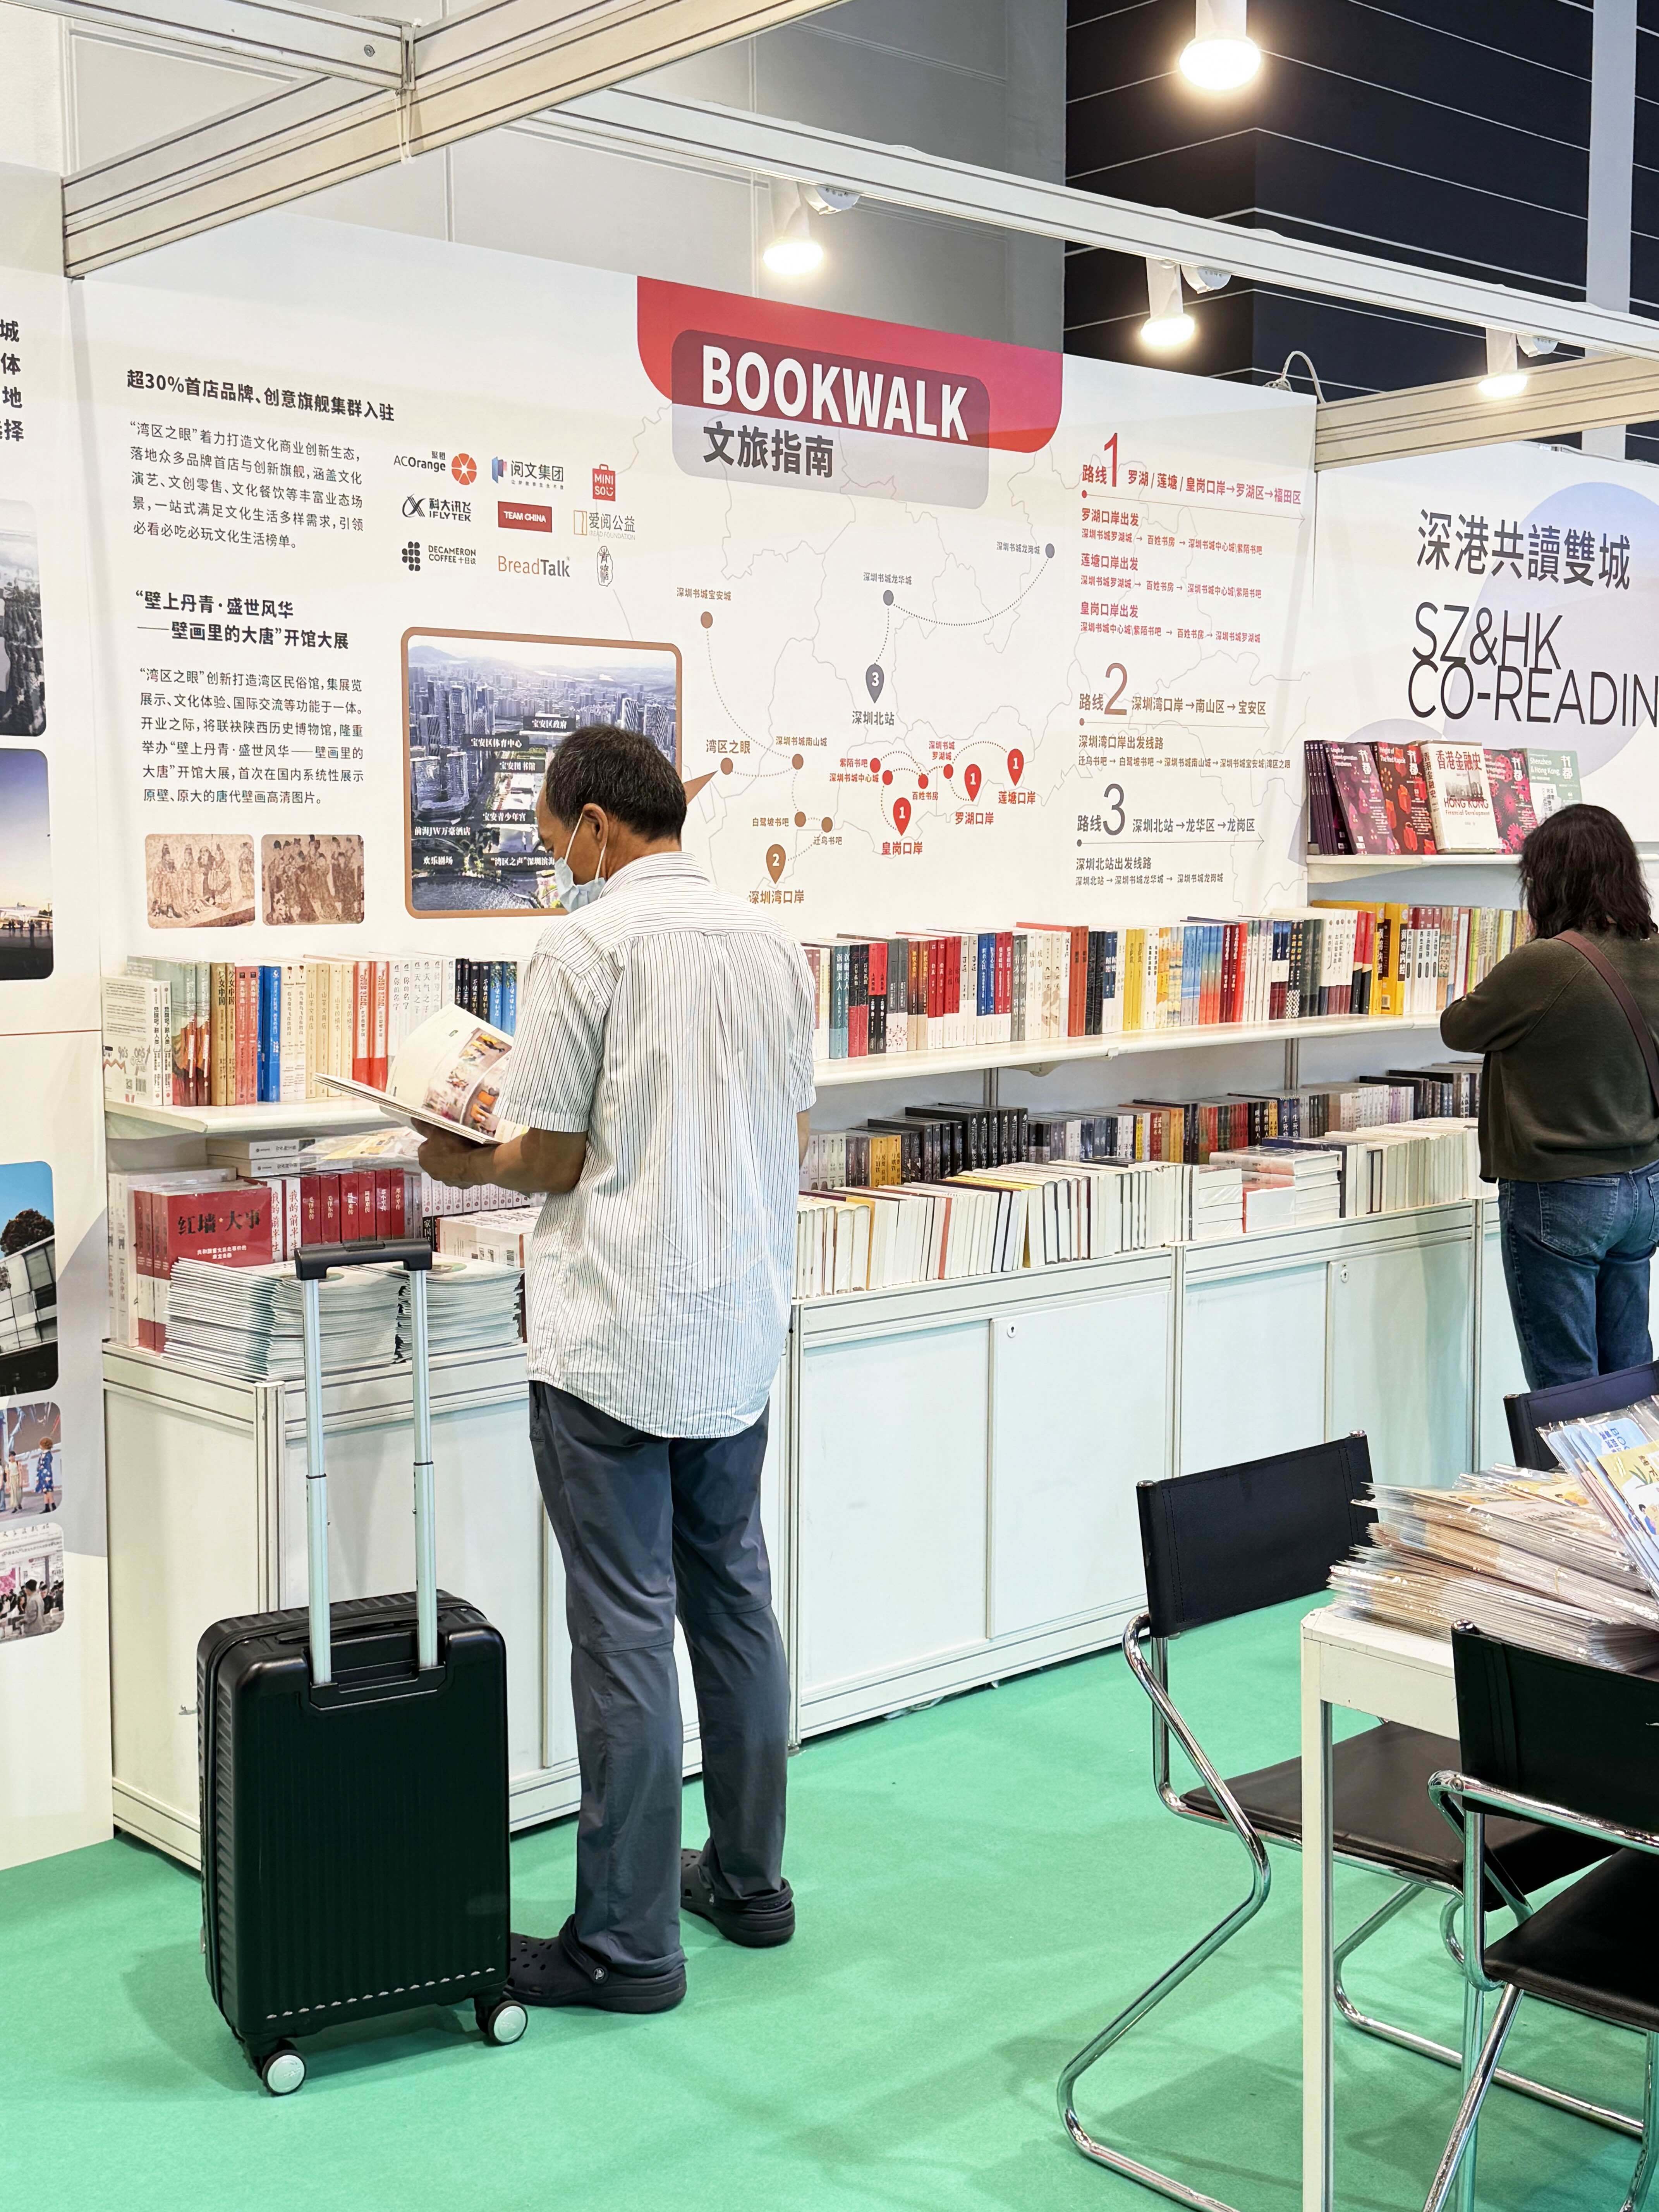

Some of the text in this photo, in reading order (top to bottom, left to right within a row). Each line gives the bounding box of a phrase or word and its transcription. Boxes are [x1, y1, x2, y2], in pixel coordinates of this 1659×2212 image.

[0, 319, 20, 342] 城
[0, 352, 21, 375] 体
[2, 386, 22, 409] 地
[127, 369, 394, 423] 超30%首店品牌、创意旗舰集群入驻
[702, 344, 969, 442] BOOKWALK
[0, 418, 24, 442] 择
[703, 421, 833, 479] 文旅指南
[393, 455, 446, 472] ACOrange
[1104, 432, 1117, 487] 1
[511, 460, 563, 482] 阅文集团
[594, 474, 614, 484] MINI
[429, 498, 471, 513] 科大讯飞
[429, 510, 471, 522] IFLYTEK
[503, 511, 546, 524] TEAM CHINA
[589, 511, 635, 532] 爱阅公益
[1081, 508, 1139, 527] 罗湖口岸出发
[133, 521, 297, 549] 必看必吃必玩文化生活榜单。
[428, 545, 476, 557] DECAMERON
[1416, 508, 1631, 590] 深港共讀雙城
[428, 553, 457, 564] COFFEE
[498, 555, 570, 577] BreadTalk
[1081, 553, 1139, 571] 莲塘口岸出发
[863, 571, 912, 586] 深圳书城龙华城
[676, 587, 732, 601] 深圳书城宝安城
[1080, 601, 1139, 618] 皇岗口岸出发
[1412, 601, 1564, 670] SZ&HK
[871, 672, 879, 687] 3
[1104, 662, 1128, 716] 2
[1408, 659, 1658, 728] CO-READIN
[1132, 696, 1266, 715] 深圳湾口岸 南山区 宝安区
[852, 710, 895, 727] 深圳北站
[706, 739, 750, 754] 湾区之眼
[776, 736, 828, 747] 深圳书城南山城
[1079, 735, 1164, 750] 深圳湾口岸出发线路
[1013, 757, 1018, 769] 1
[1435, 750, 1482, 771] 香港金融史
[829, 773, 879, 783] 深圳书城中心城
[970, 773, 976, 785] 1
[998, 791, 1036, 805] 莲塘口岸
[1444, 797, 1489, 809] HONG KONG
[899, 806, 905, 819] 1
[955, 811, 994, 825] 罗湖口岸
[1103, 783, 1126, 836] 3
[1132, 817, 1255, 833] 深圳北站 龙华区 龙岗区
[881, 842, 923, 855] 皇岗口岸
[772, 854, 780, 866] 2
[1076, 857, 1152, 871] 深圳北站出发线路
[749, 890, 805, 904] 深圳湾口岸
[177, 1209, 260, 1235] 红墙 大事
[289, 1190, 298, 1251] 我的前半生
